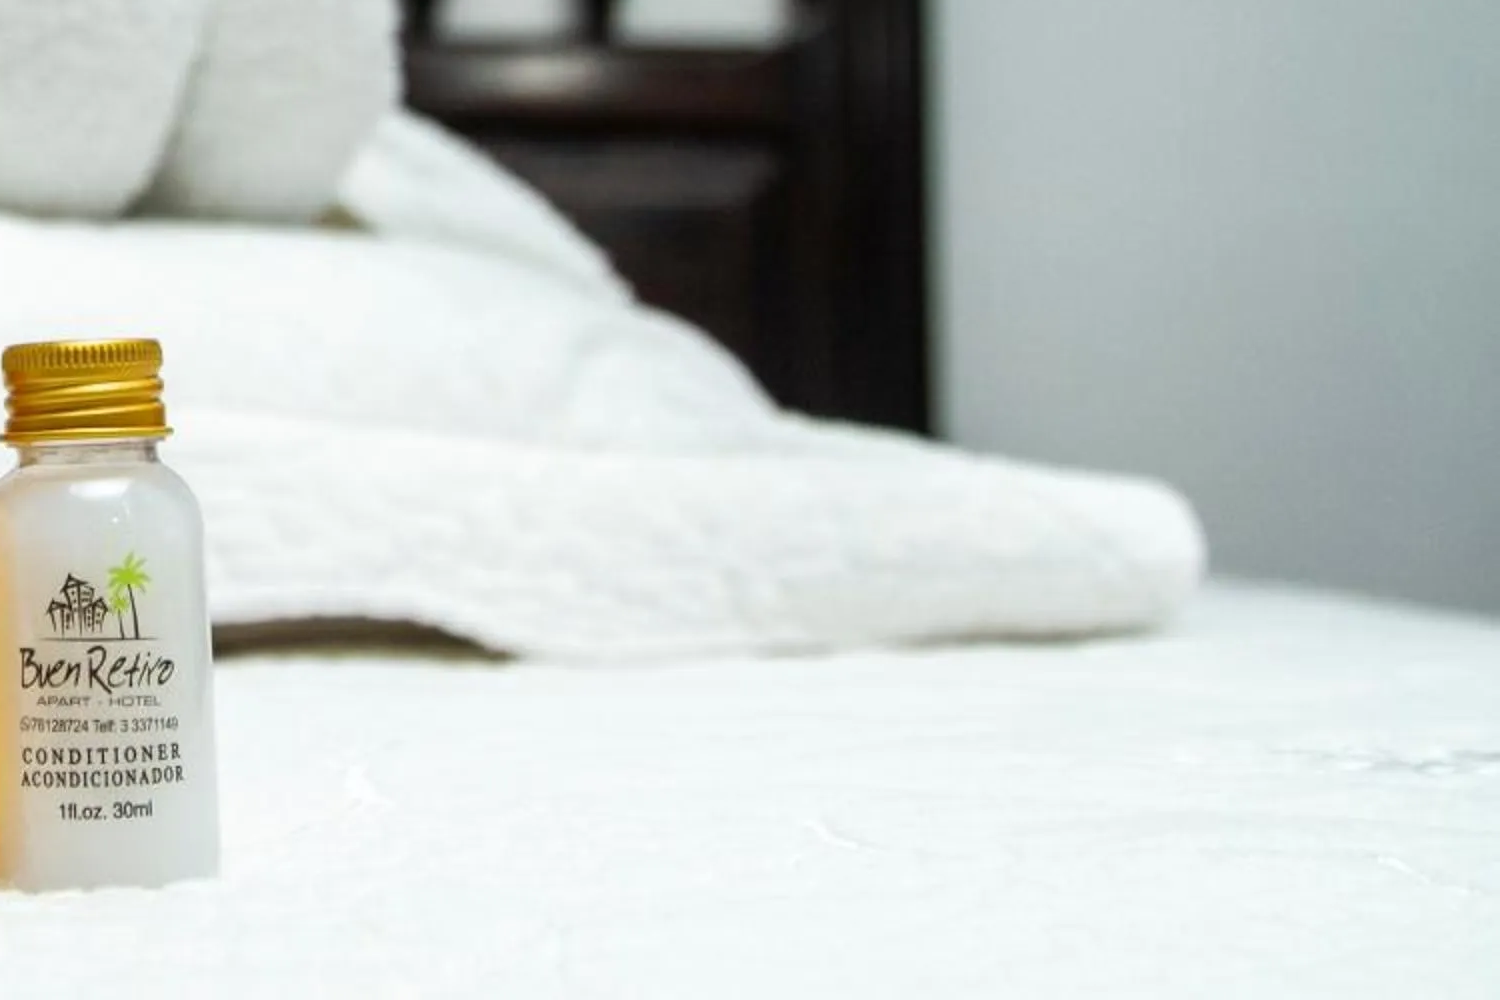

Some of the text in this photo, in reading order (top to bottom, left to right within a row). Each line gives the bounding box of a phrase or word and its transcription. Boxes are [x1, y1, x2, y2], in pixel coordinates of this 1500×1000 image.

[22, 743, 181, 765] CONDITIONER
[21, 765, 184, 788] ACONDICIONADOR
[113, 801, 153, 819] 30ml
